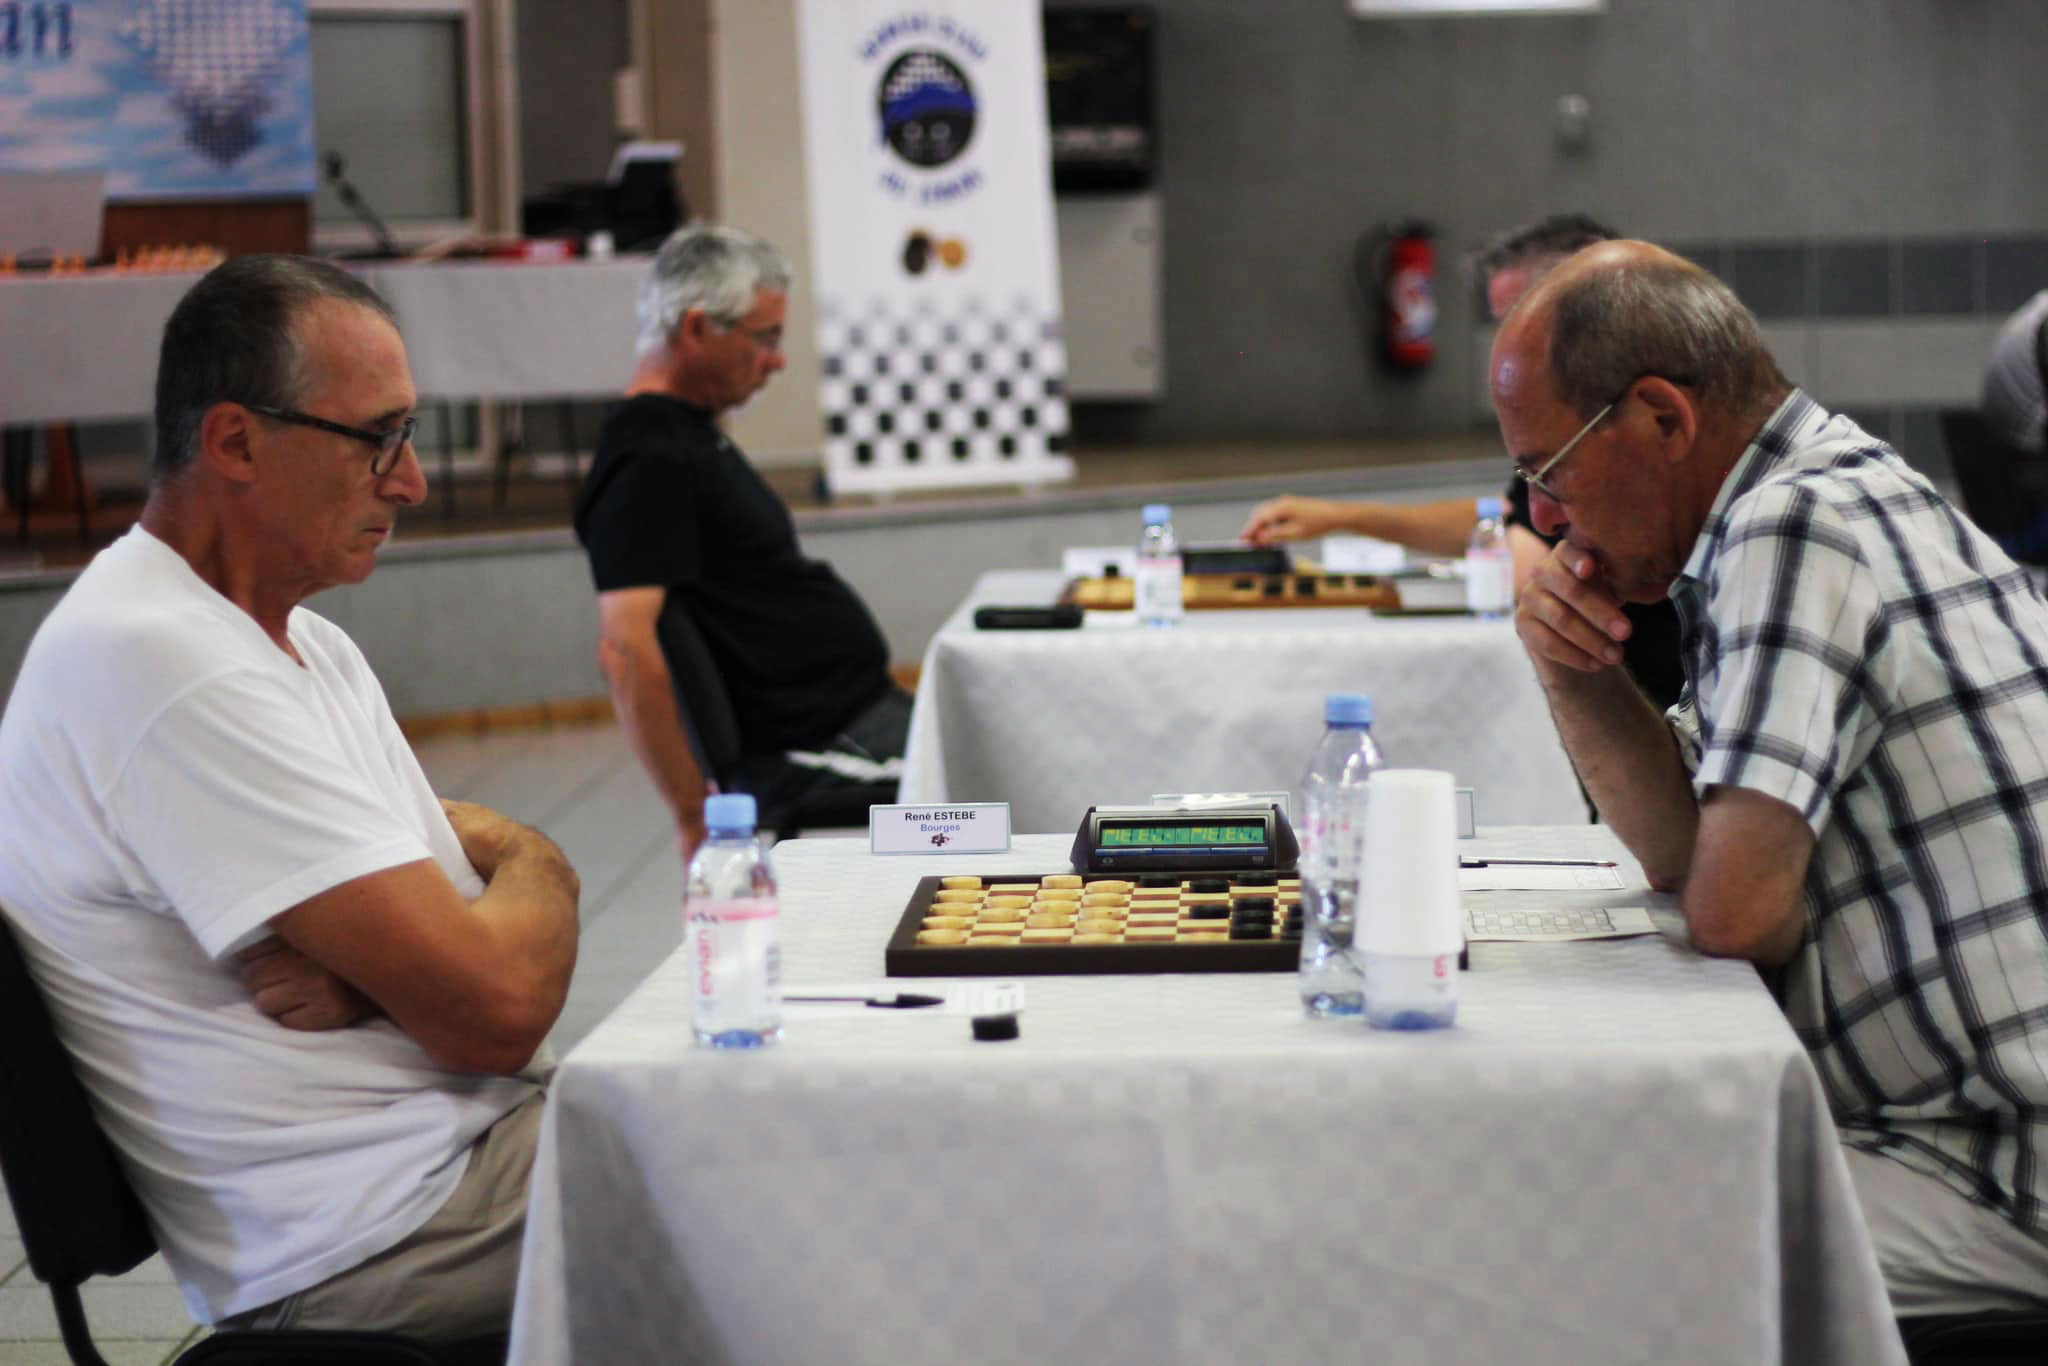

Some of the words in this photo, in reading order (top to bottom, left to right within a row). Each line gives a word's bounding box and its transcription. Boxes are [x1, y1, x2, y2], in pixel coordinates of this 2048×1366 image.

[905, 812, 931, 821] René
[934, 811, 976, 821] ESTEBE
[920, 823, 960, 833] Bourges
